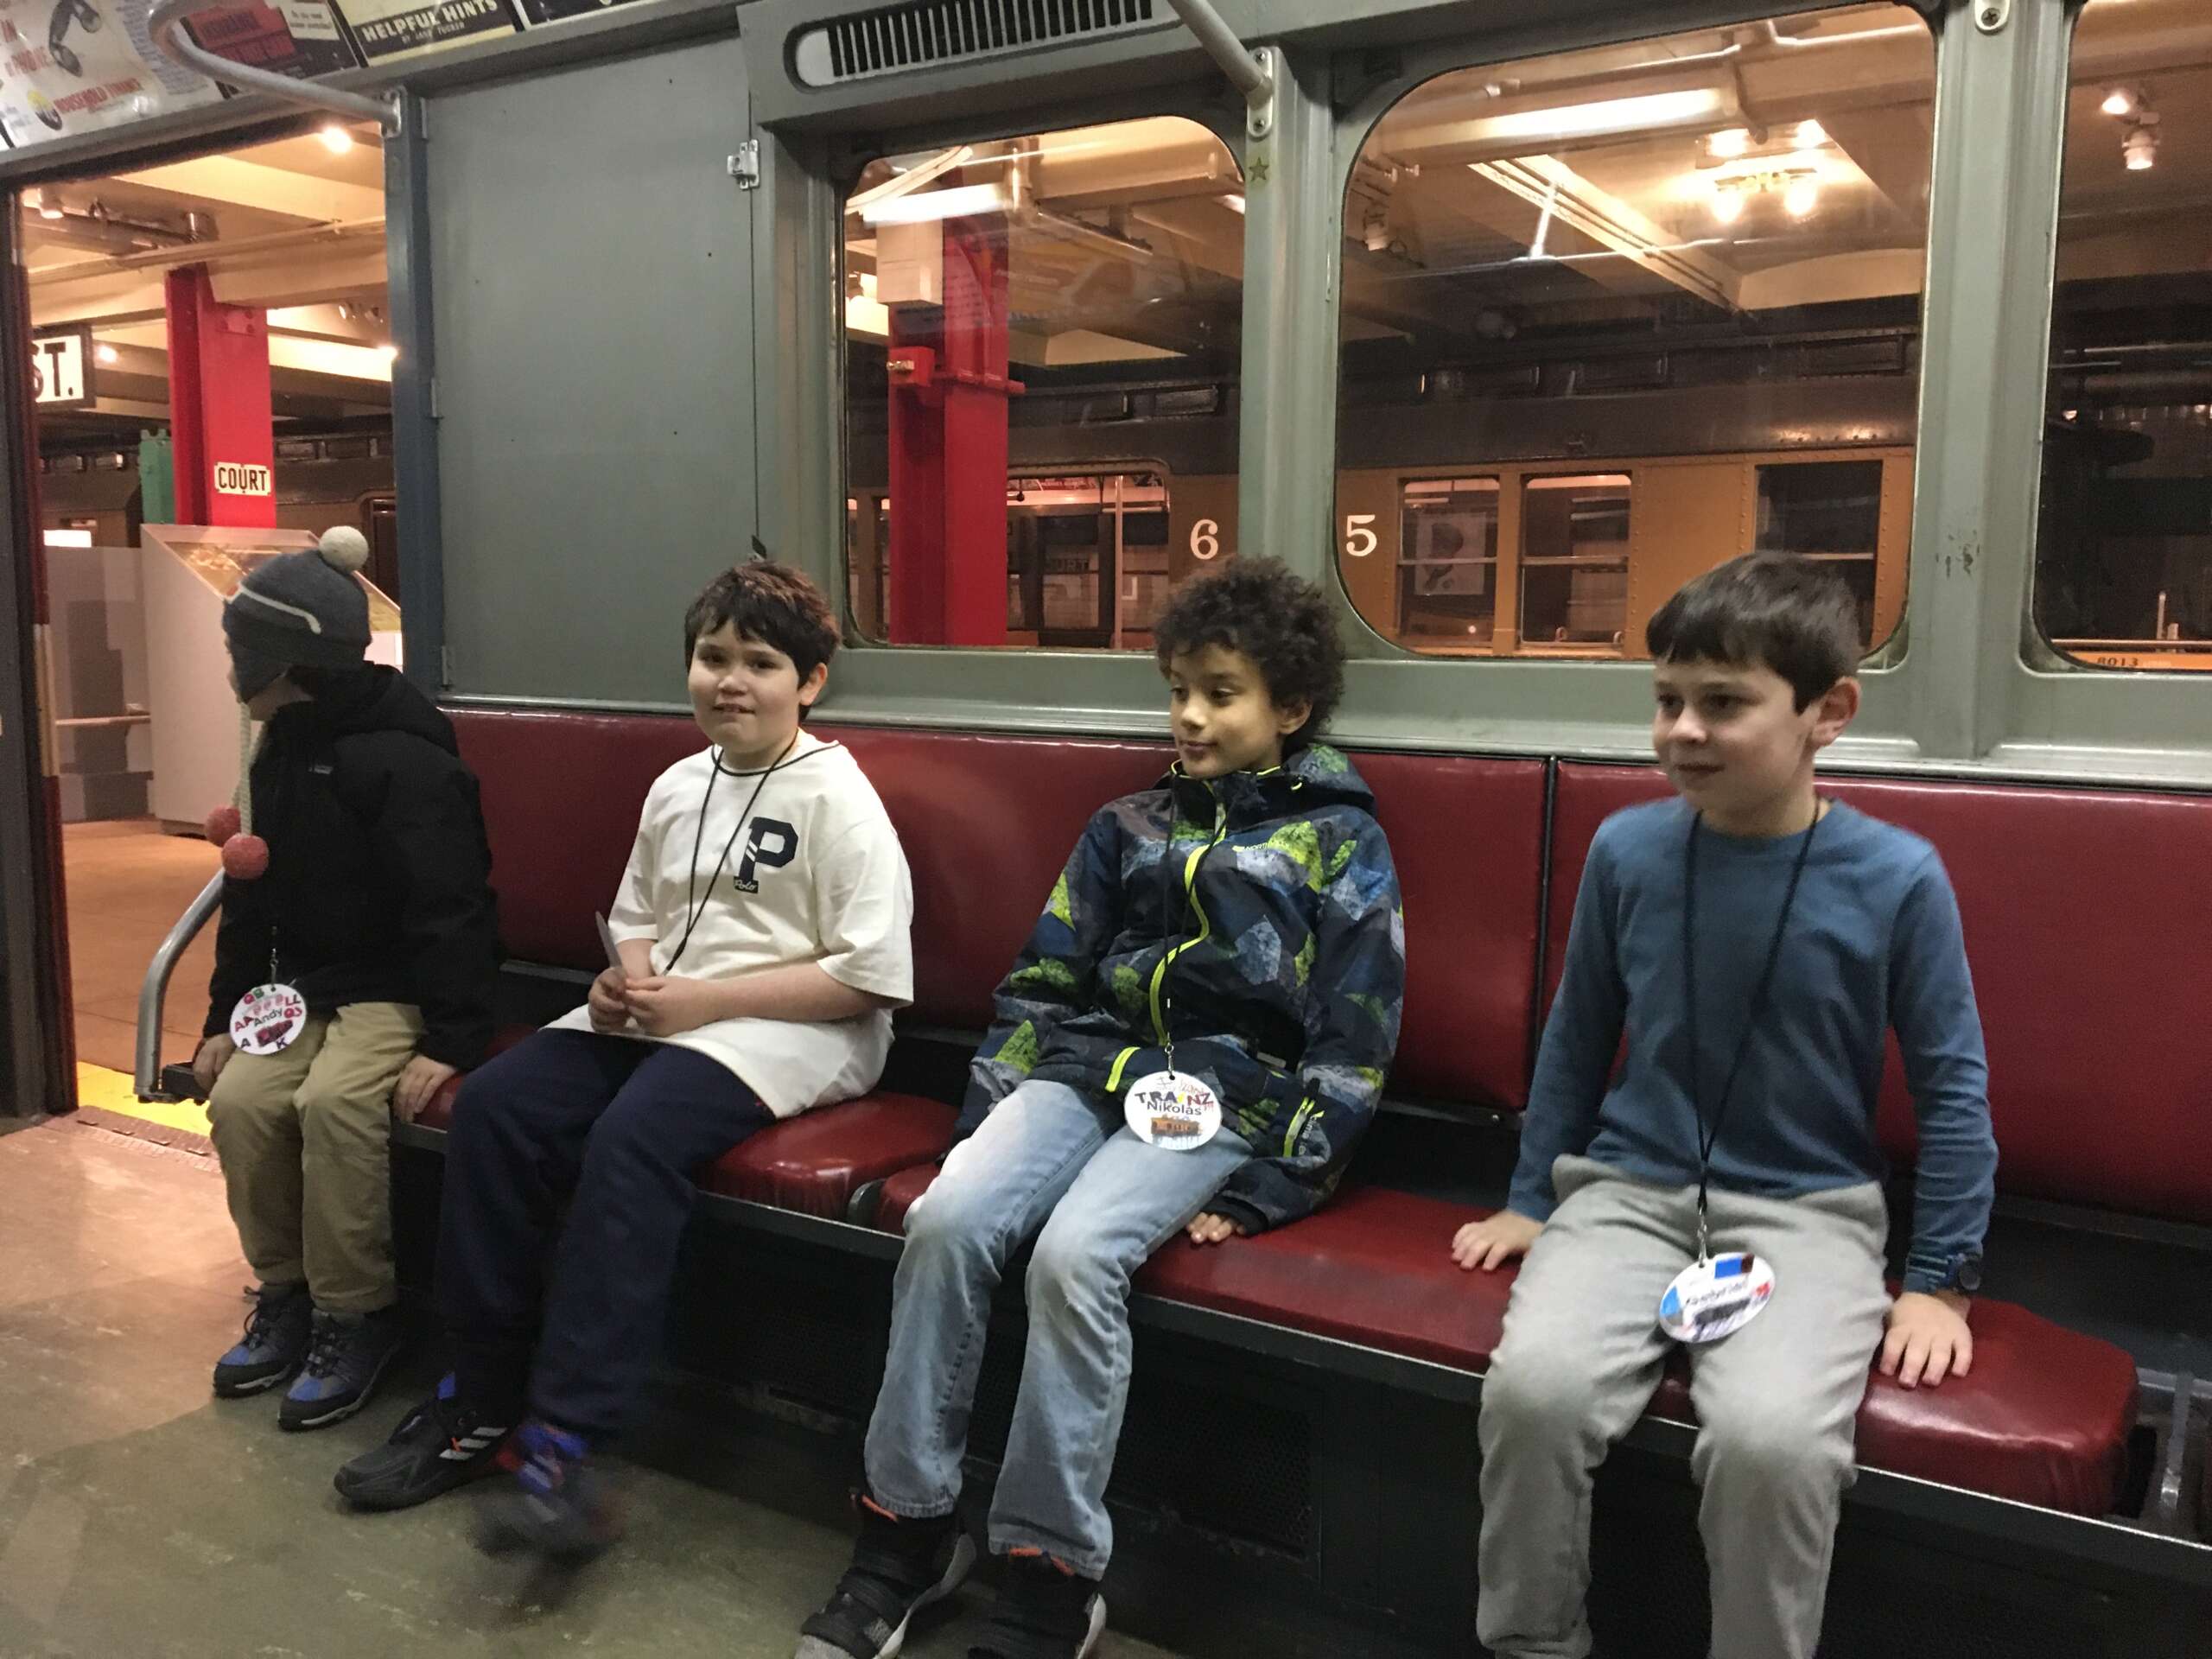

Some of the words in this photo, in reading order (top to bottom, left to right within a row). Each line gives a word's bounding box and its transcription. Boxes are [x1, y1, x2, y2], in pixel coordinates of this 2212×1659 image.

[361, 11, 441, 42] HELPFUL
[442, 0, 498, 22] HINTS
[218, 467, 267, 492] COURT
[1190, 518, 1219, 560] 6
[1345, 514, 1377, 557] 5
[2096, 656, 2139, 667] 8013
[733, 816, 799, 894] P
[253, 1007, 283, 1027] Andy
[1147, 1101, 1203, 1116] Nikolas
